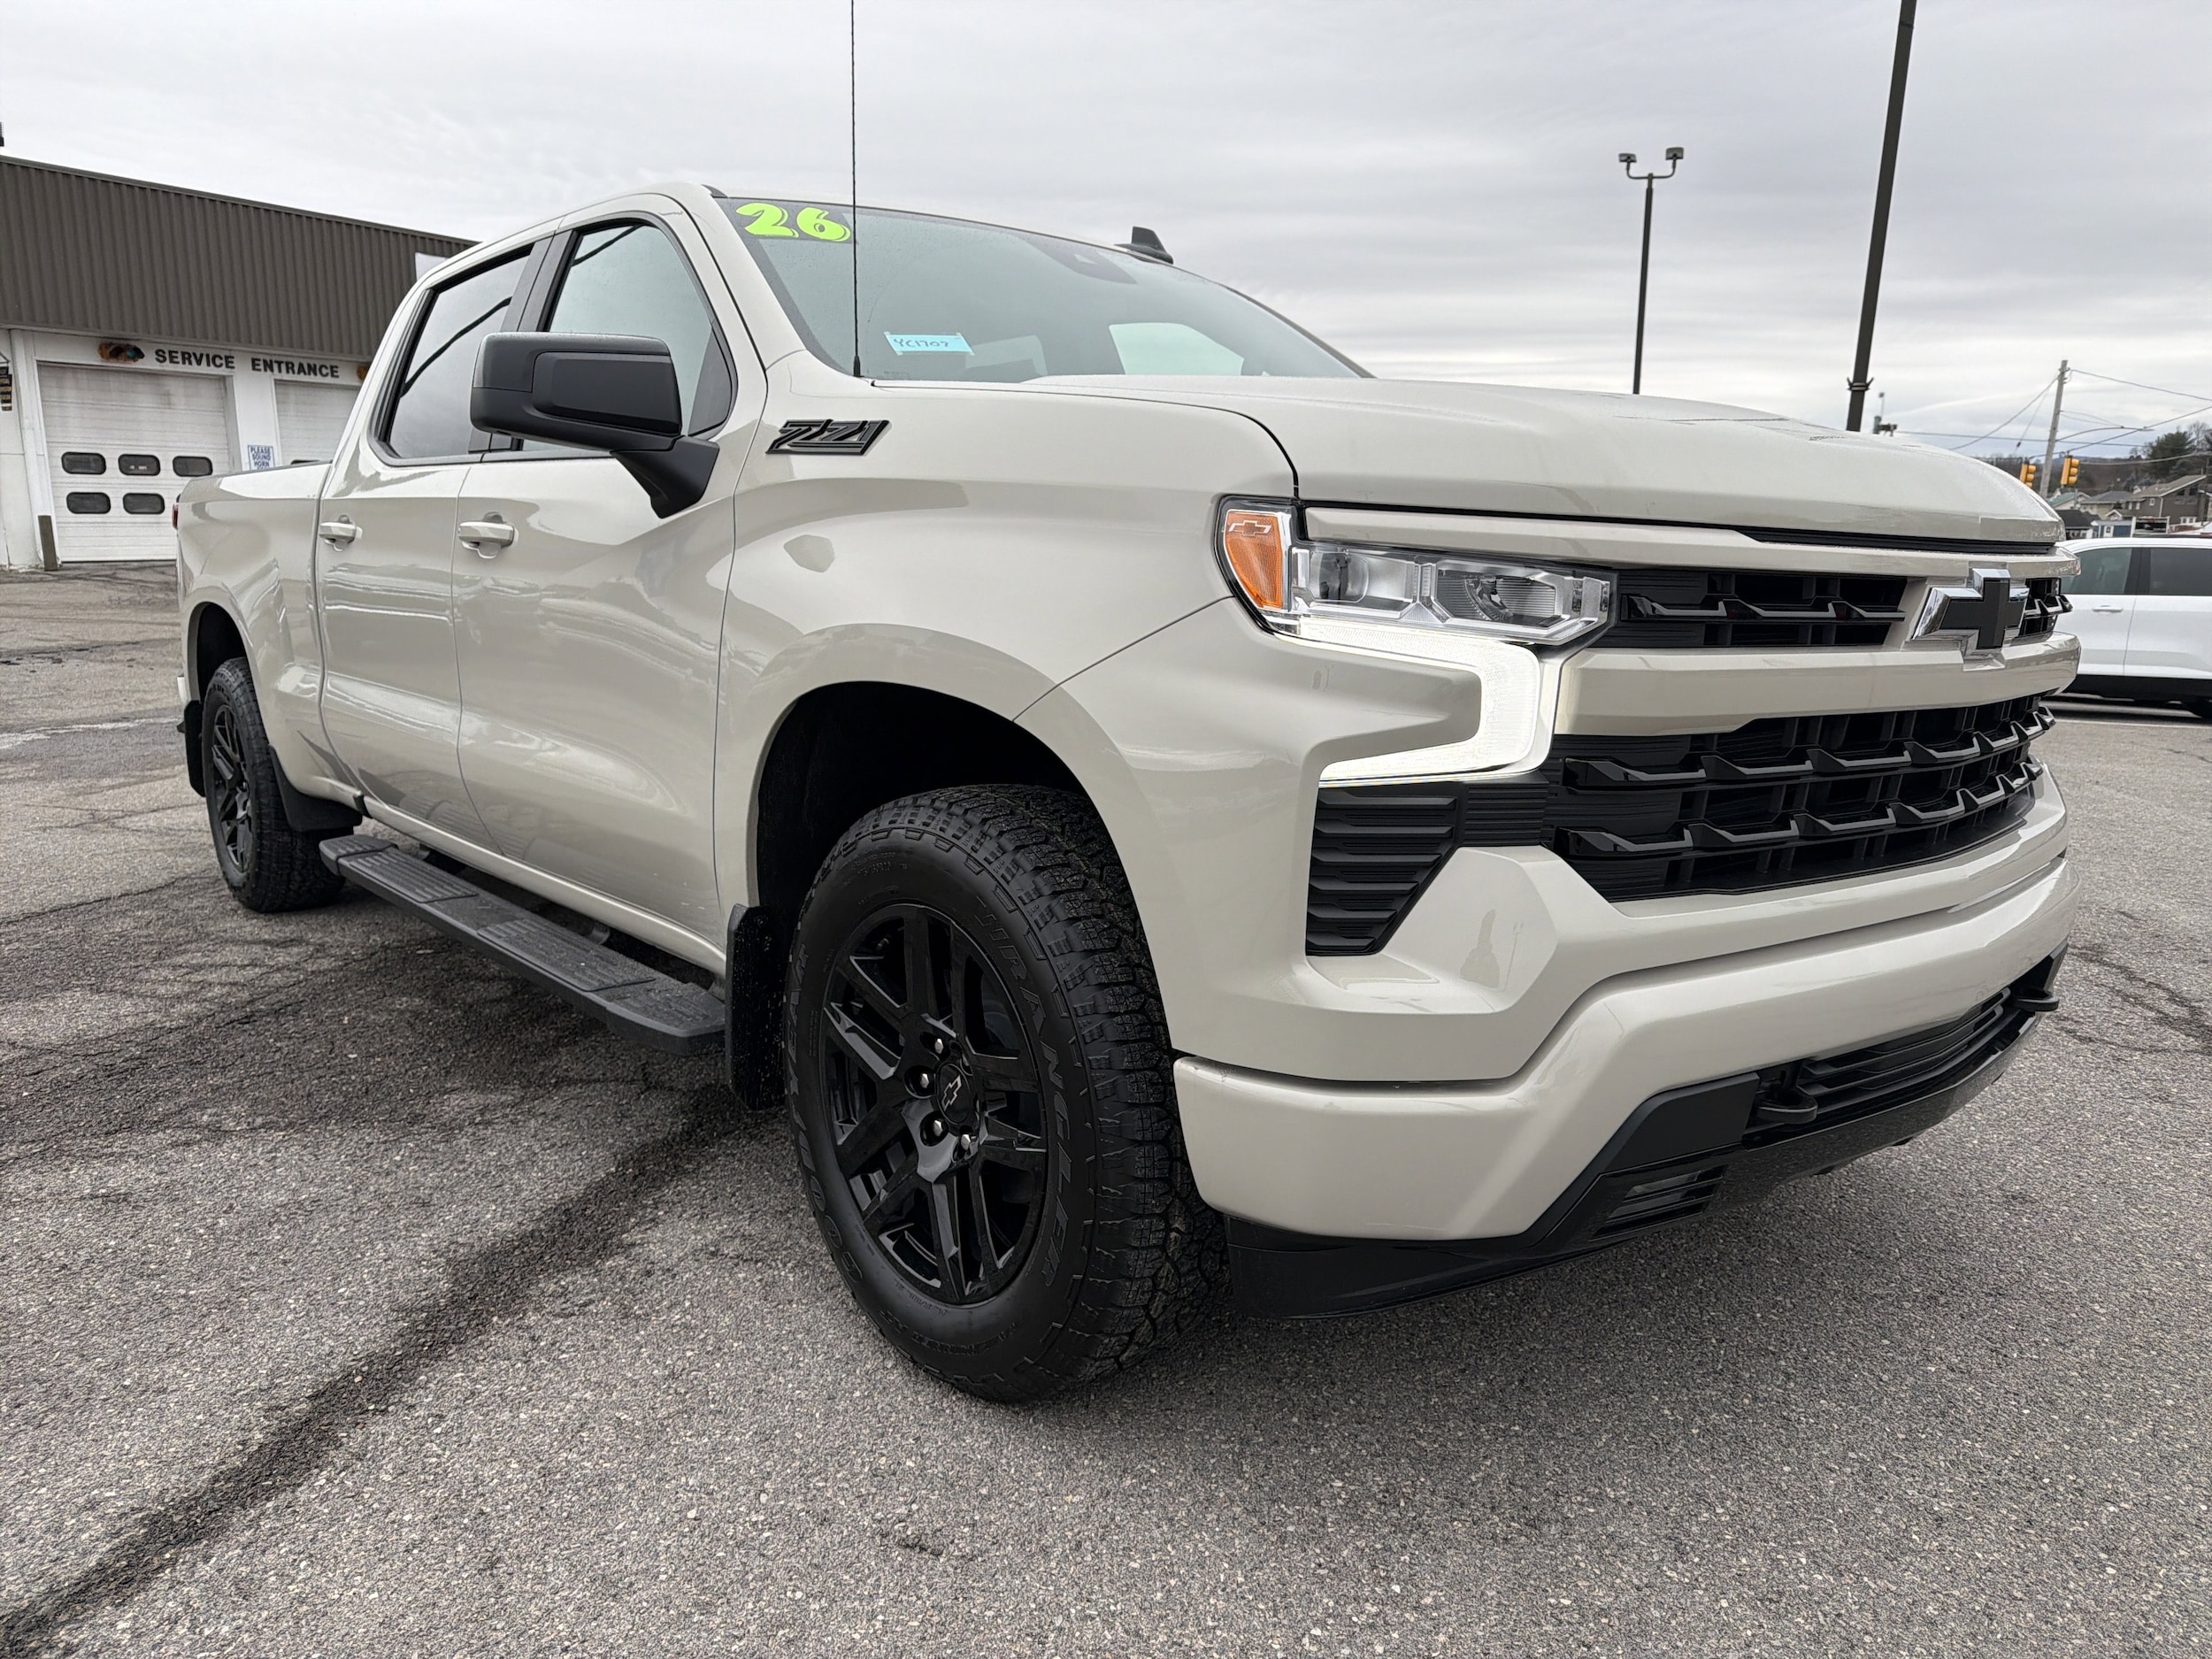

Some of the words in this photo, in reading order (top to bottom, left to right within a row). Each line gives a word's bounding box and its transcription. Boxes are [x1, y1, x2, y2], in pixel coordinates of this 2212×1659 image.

[736, 203, 850, 242] 26
[155, 349, 235, 369] SERVICE
[250, 357, 340, 378] ENTRANCE
[765, 419, 890, 456] Z71
